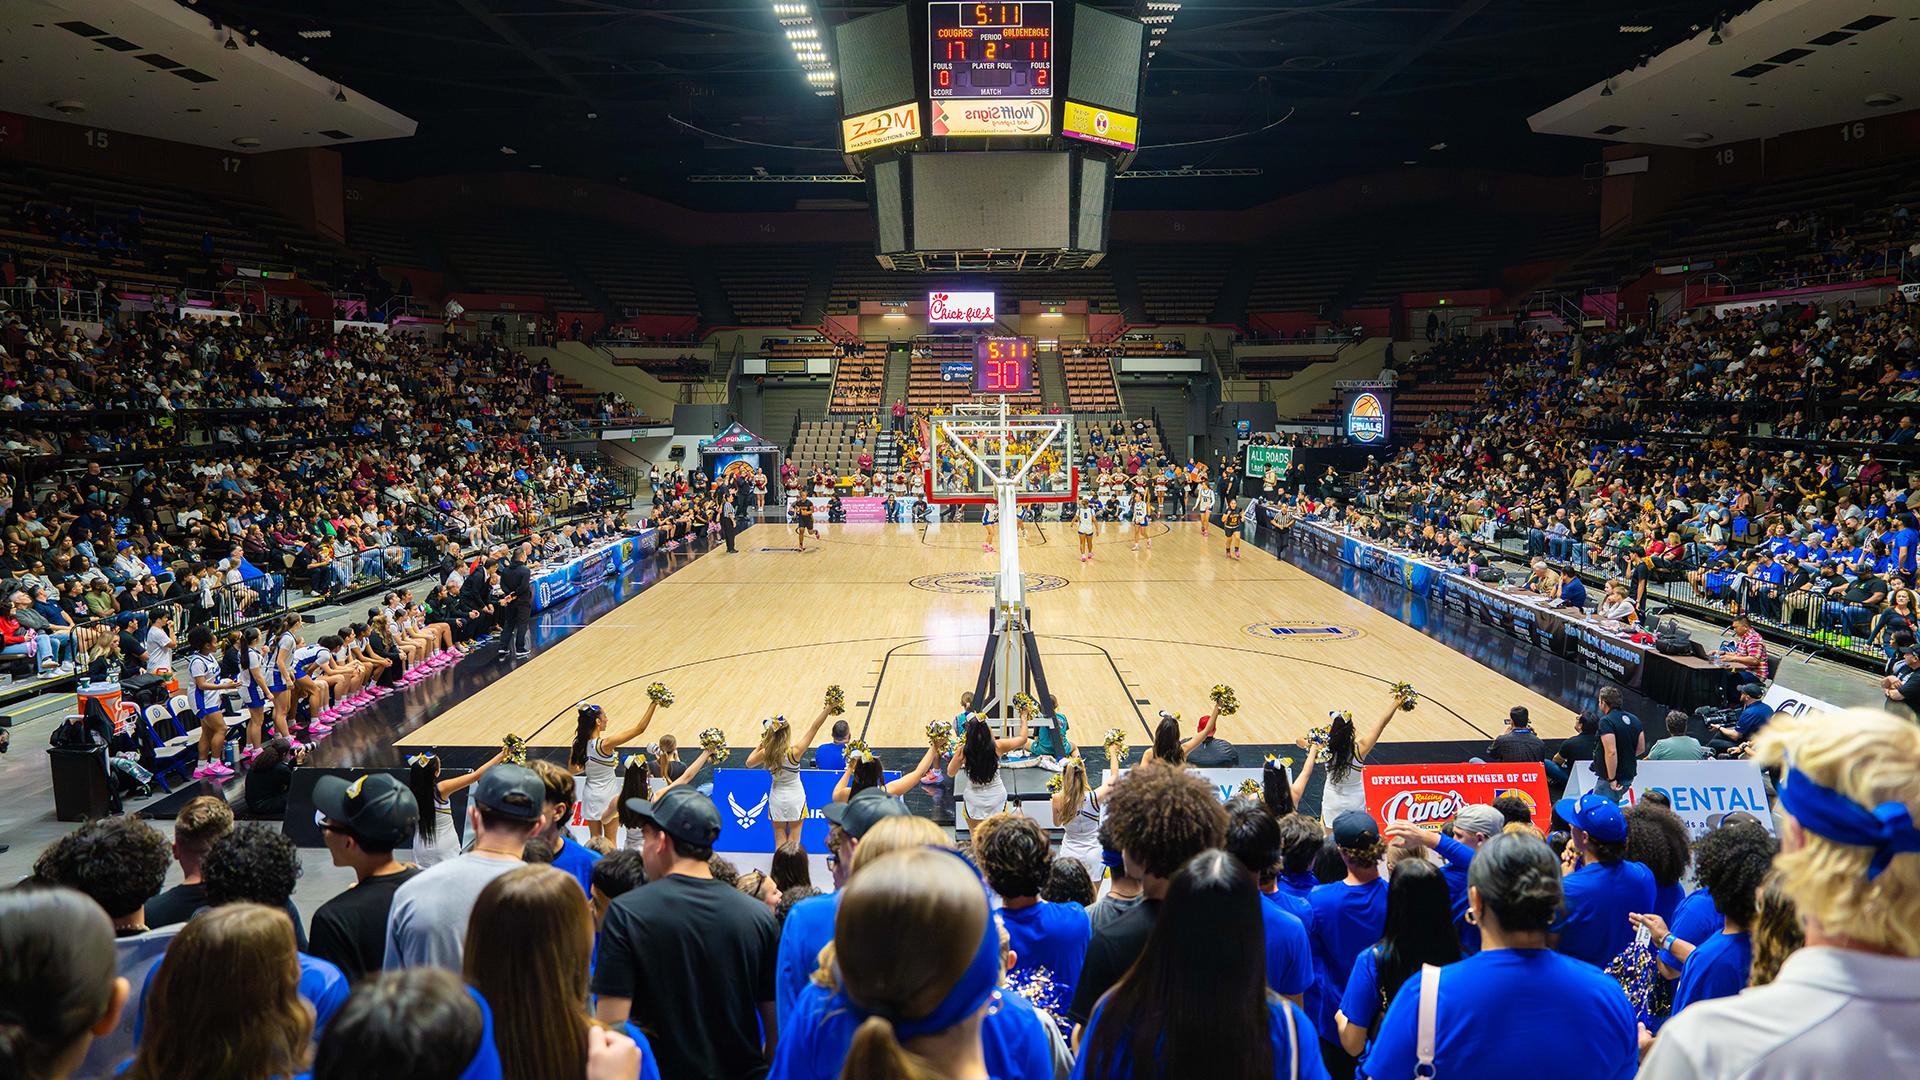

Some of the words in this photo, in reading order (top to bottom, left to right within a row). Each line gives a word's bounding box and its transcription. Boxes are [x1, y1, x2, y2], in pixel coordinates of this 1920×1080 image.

[976, 5, 1018, 24] 5:11
[938, 29, 973, 38] COUGARS
[948, 41, 965, 59] 17
[986, 42, 996, 58] 2
[1031, 41, 1047, 59] 11
[1037, 69, 1047, 85] 2
[849, 109, 915, 141] ZOOM
[1840, 122, 1864, 142] 16
[84, 129, 109, 148] 15
[222, 157, 241, 173] 17
[1715, 148, 1734, 166] 18
[930, 293, 994, 323] Chick-fil-A
[989, 342, 1027, 358] 5:11
[987, 361, 1019, 389] 30
[1352, 421, 1382, 432] FINALS
[1251, 451, 1264, 462] ALL
[1265, 451, 1289, 463] ROADS
[1600, 639, 1640, 665] Sponsors
[1371, 775, 1418, 785] OFFICIAL
[1420, 774, 1465, 784] CHICKEN
[1466, 773, 1505, 783] FINGER
[1507, 773, 1519, 782] OF
[1521, 773, 1538, 782] CIF
[1415, 793, 1443, 802] Raising
[1387, 790, 1464, 825] Cane's
